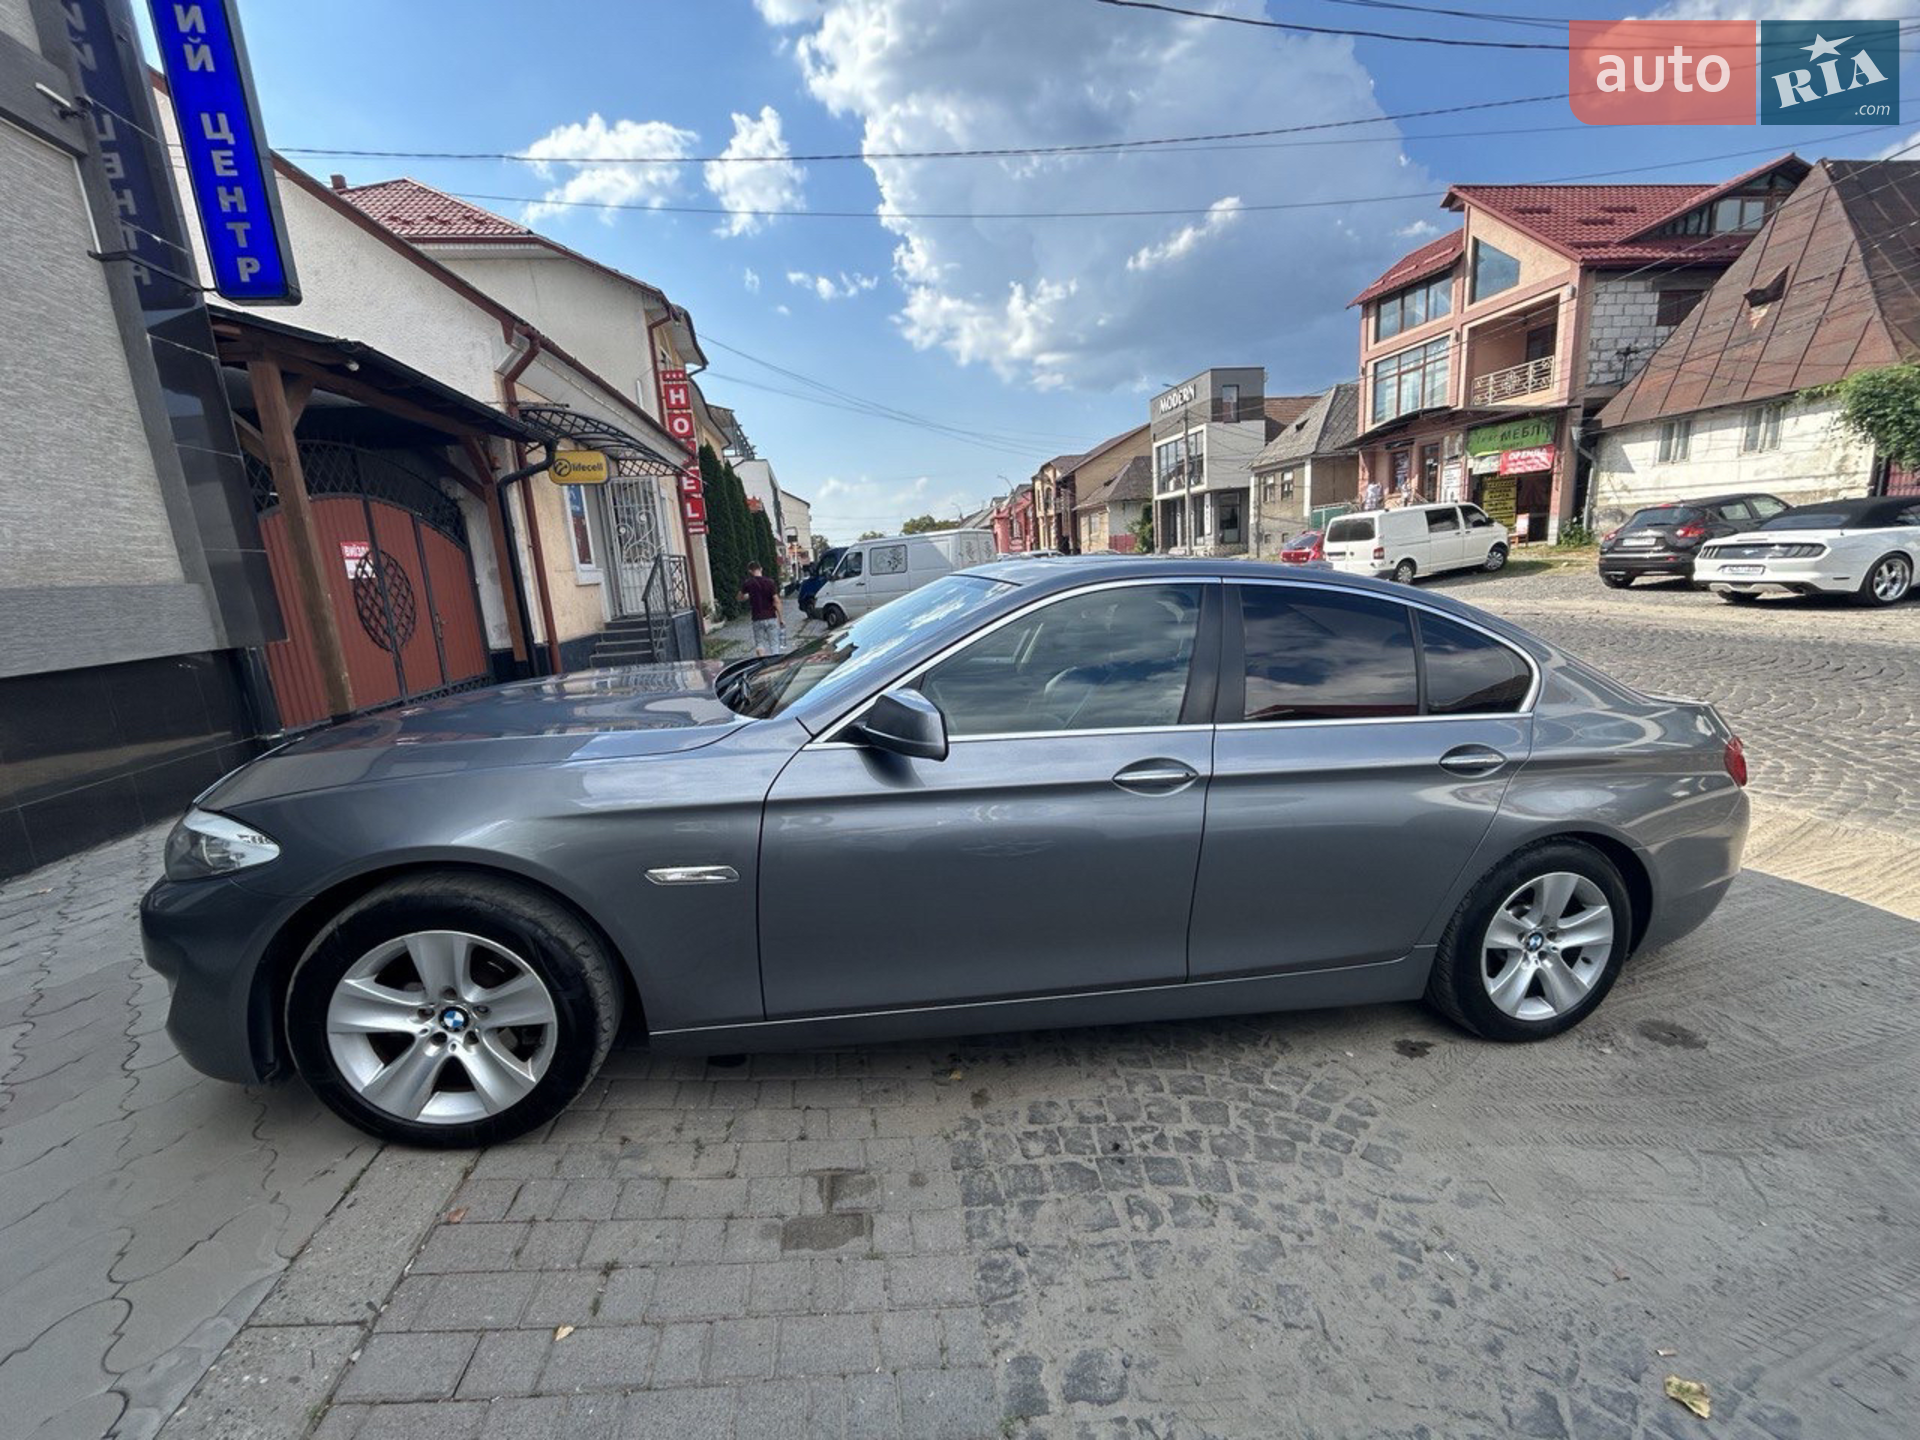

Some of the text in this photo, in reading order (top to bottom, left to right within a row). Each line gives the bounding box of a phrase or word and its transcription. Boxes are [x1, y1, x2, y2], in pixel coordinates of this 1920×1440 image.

[173, 4, 261, 283] ИЙ ЦЕНТР
[1160, 384, 1197, 414] MODERN
[571, 462, 603, 472] lifecell
[669, 388, 700, 519] HOEL
